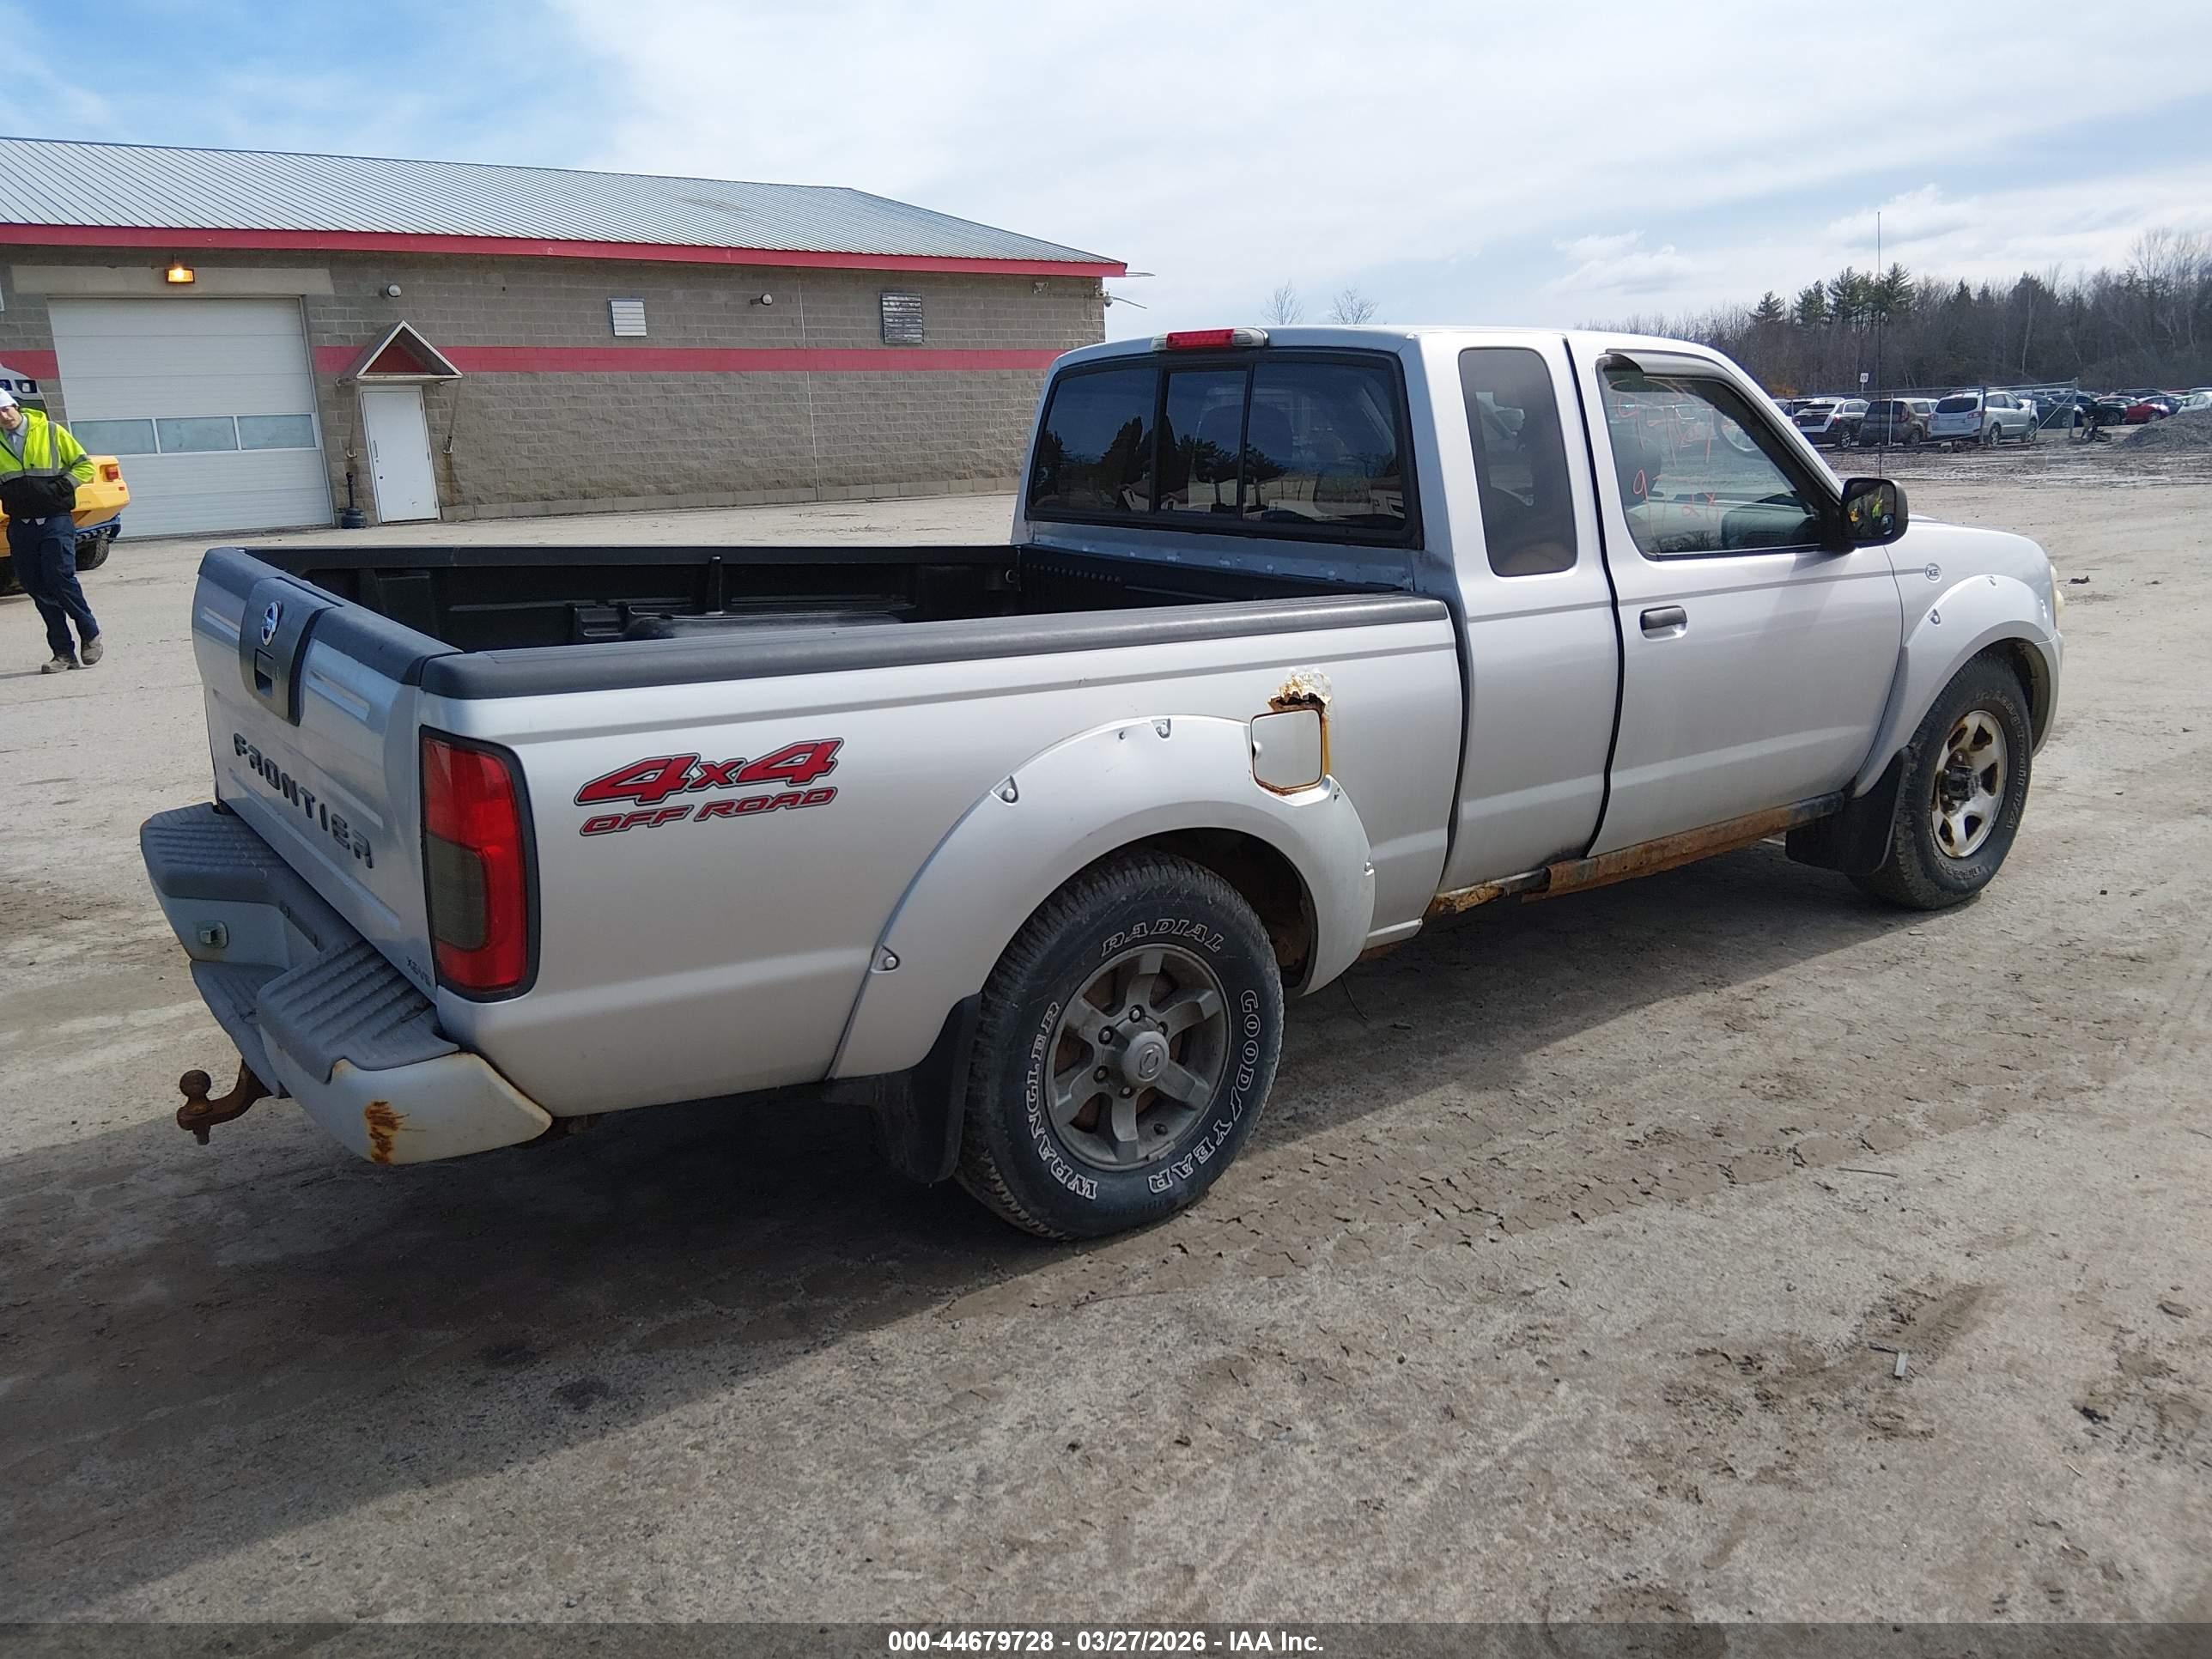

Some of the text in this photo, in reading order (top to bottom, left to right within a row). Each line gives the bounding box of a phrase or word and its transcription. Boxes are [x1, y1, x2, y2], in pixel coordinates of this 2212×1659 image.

[234, 732, 373, 869] FRONTIER
[574, 737, 844, 806] 4x4
[580, 787, 838, 836] OFF ROAD
[1100, 918, 1225, 958] RADIAL
[1024, 1001, 1099, 1200] WRANGLER
